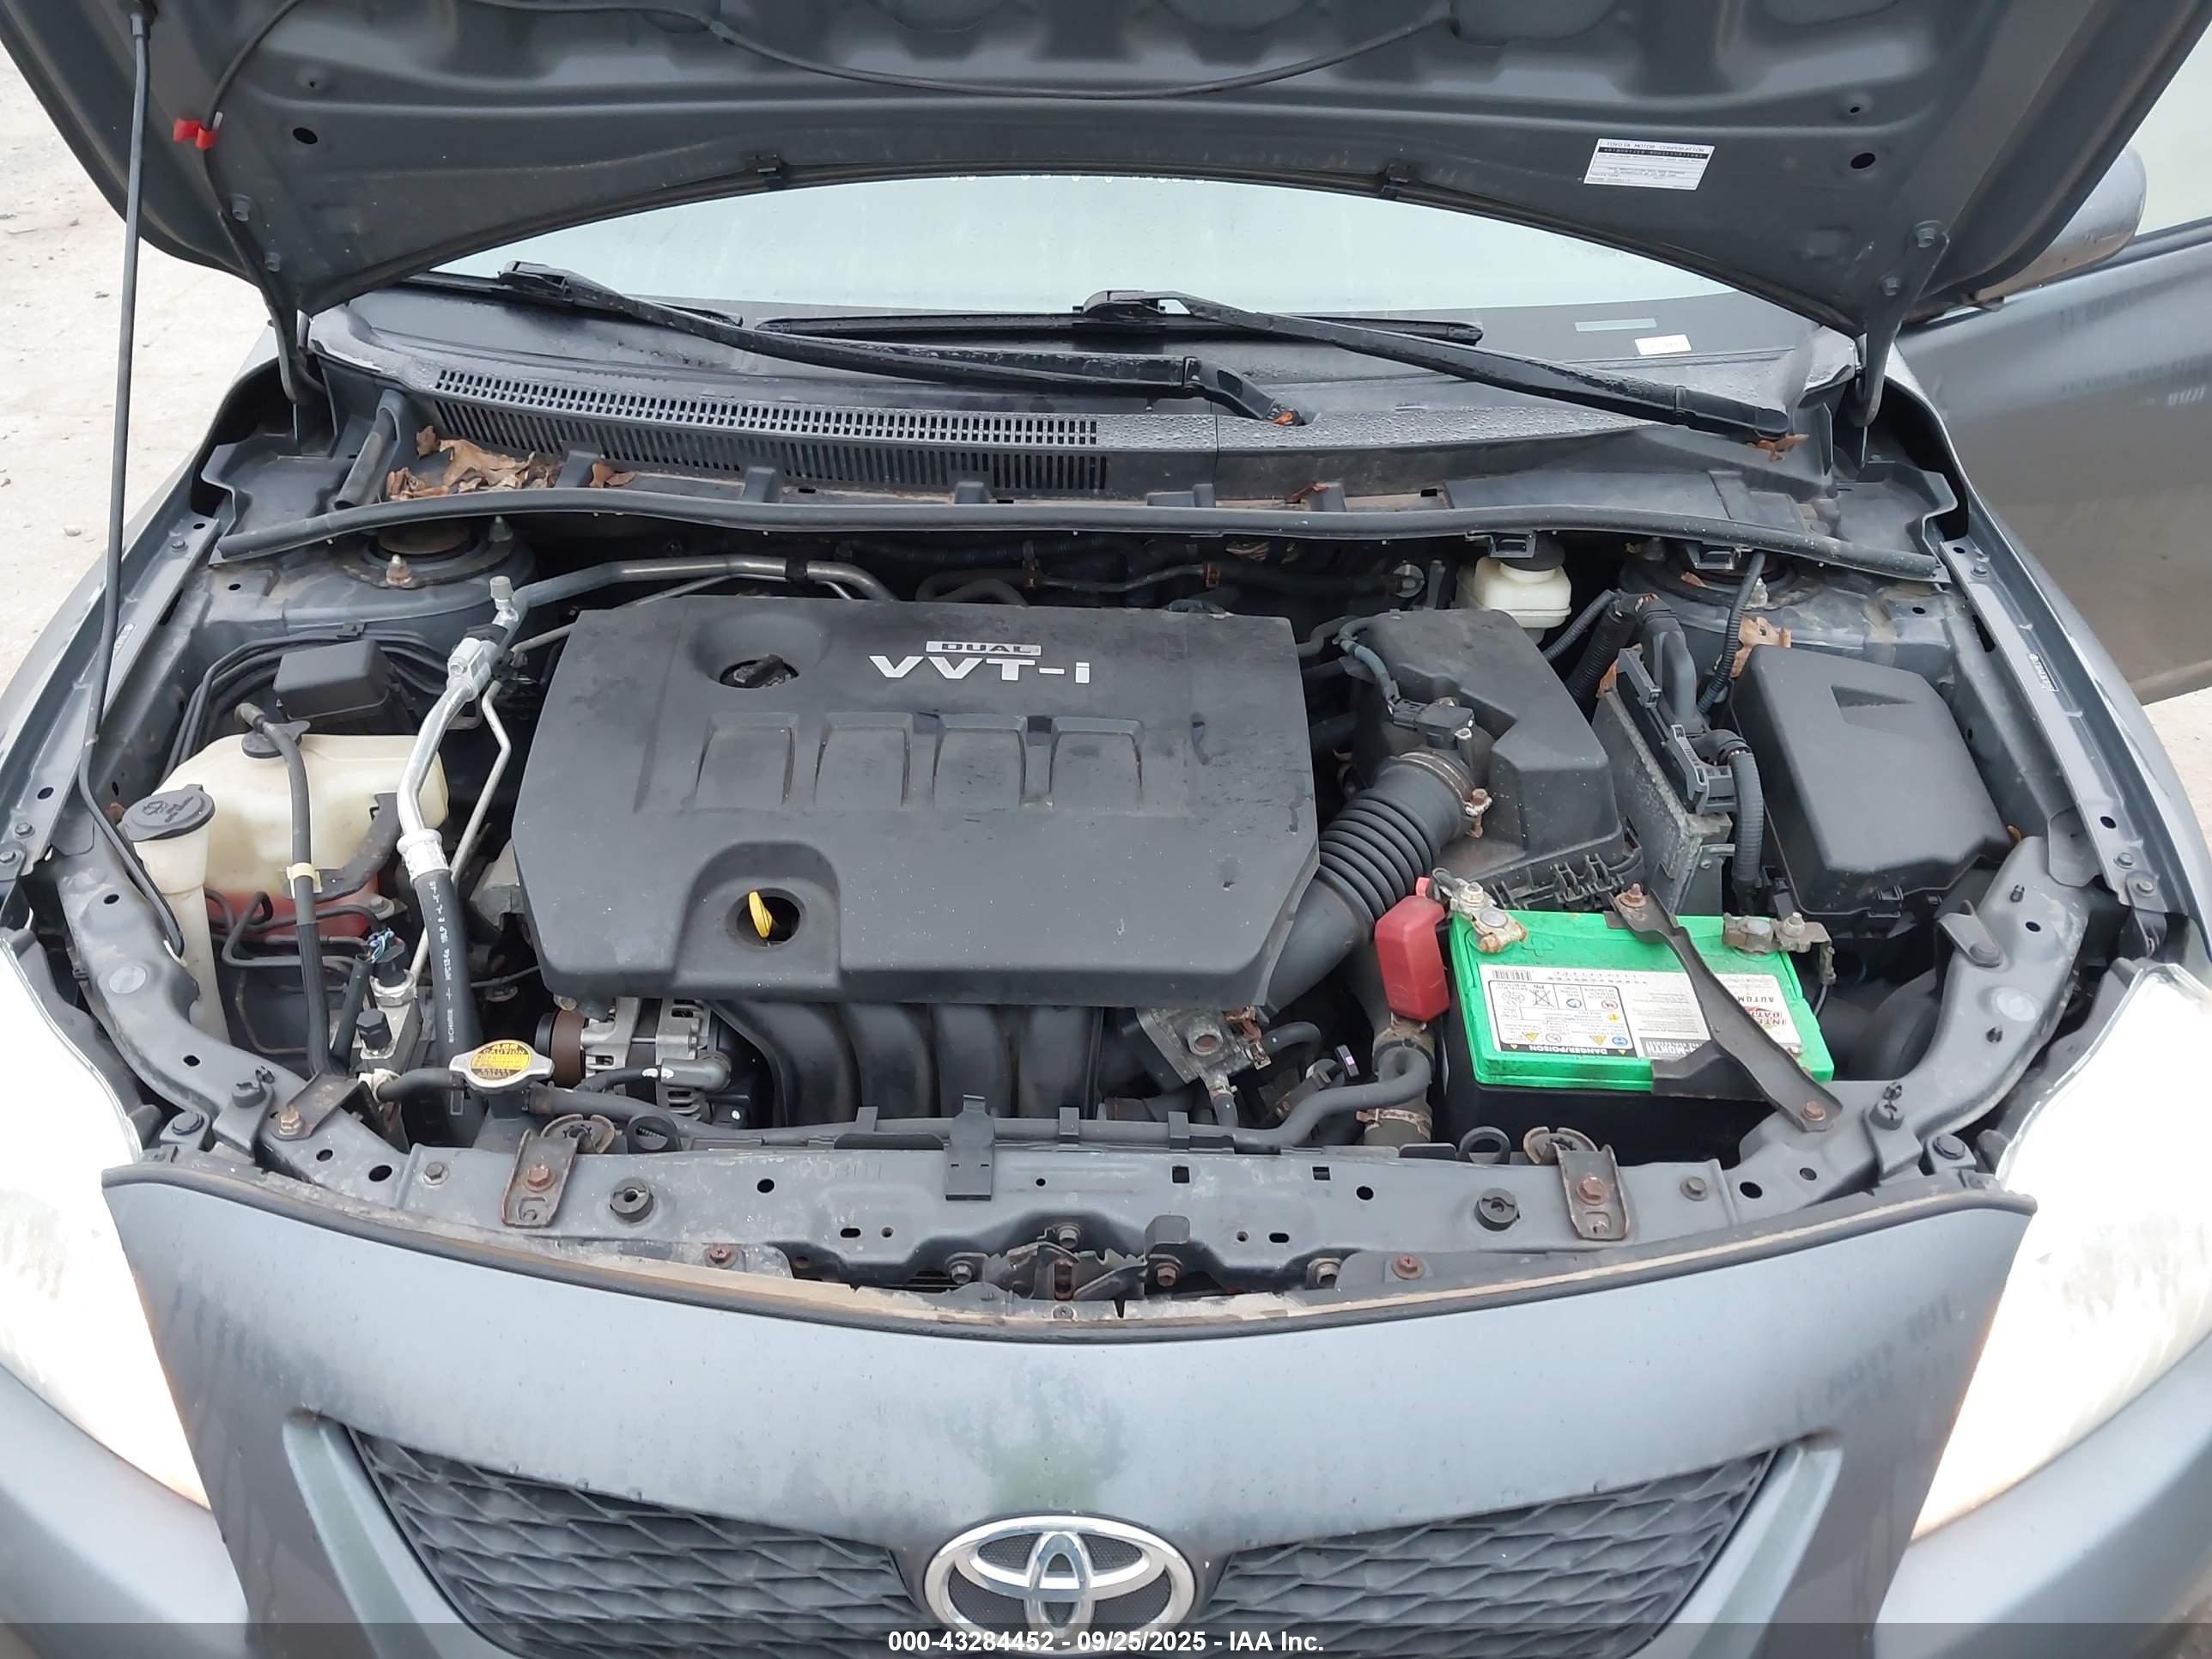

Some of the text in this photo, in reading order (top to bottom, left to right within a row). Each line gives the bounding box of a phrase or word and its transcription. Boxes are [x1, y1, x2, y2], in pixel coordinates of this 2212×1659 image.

[939, 642, 1035, 654] DUAL
[868, 655, 1091, 684] VVT-i
[1528, 1044, 1608, 1055] DANGER/POISON
